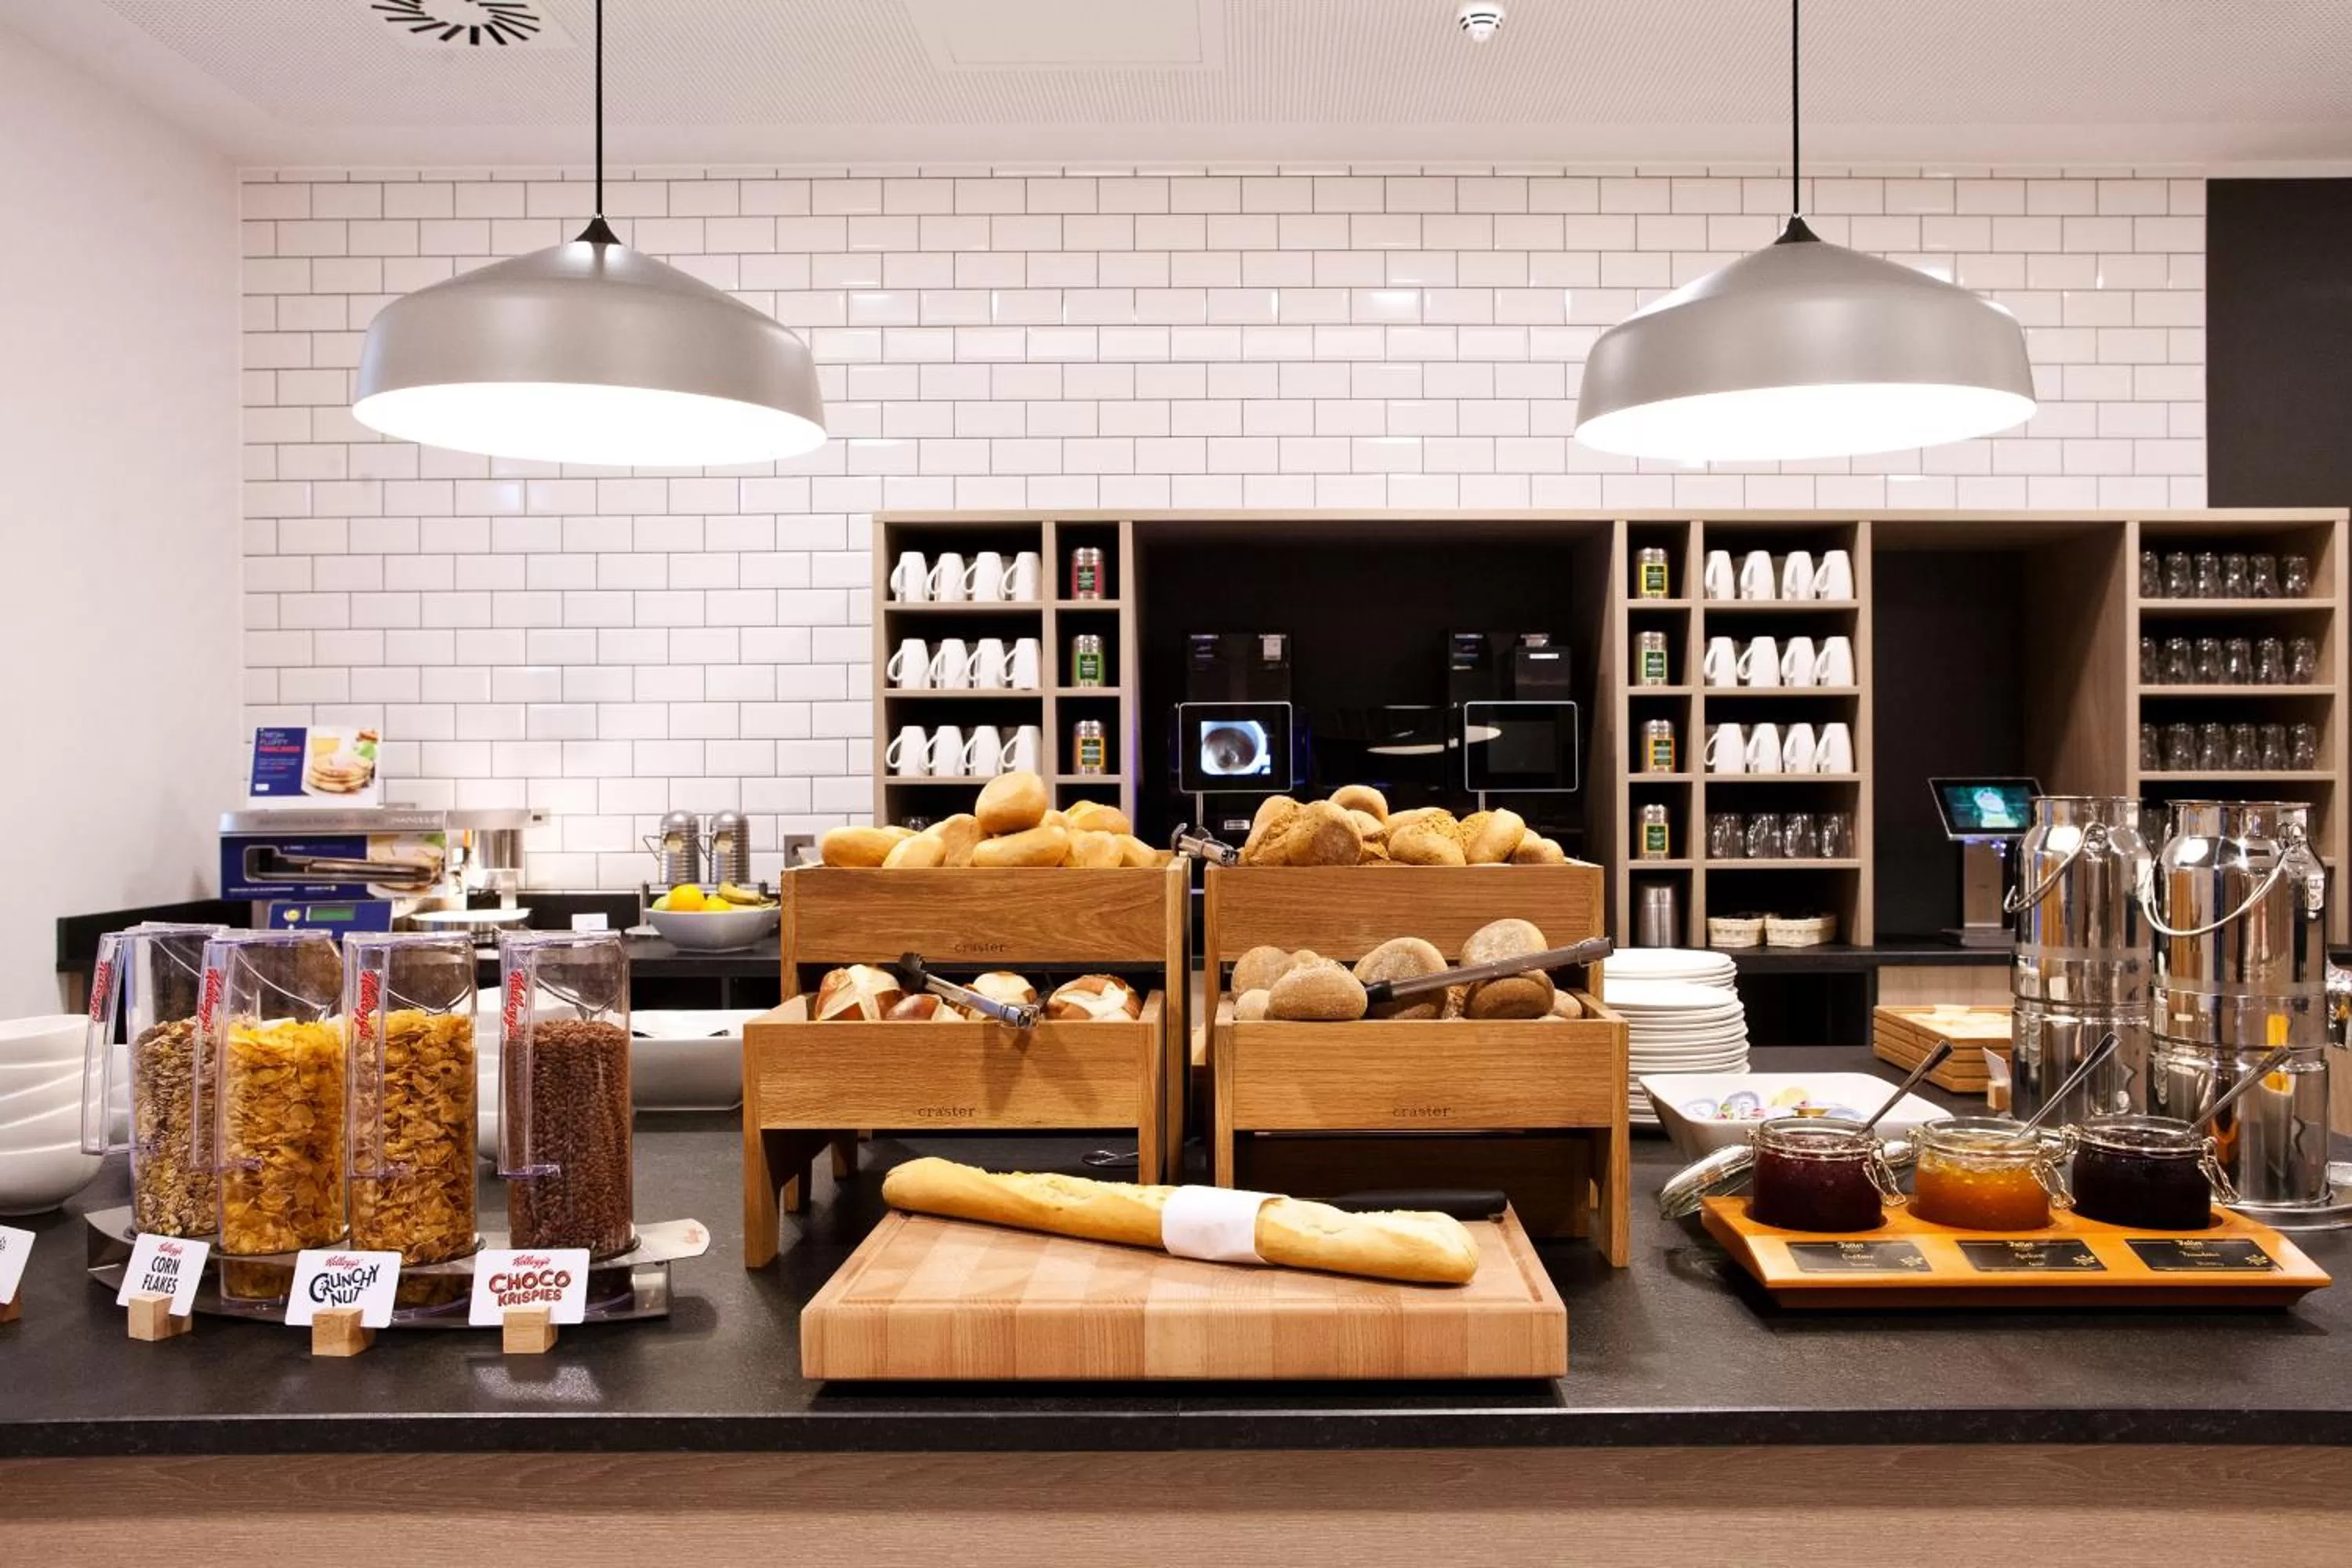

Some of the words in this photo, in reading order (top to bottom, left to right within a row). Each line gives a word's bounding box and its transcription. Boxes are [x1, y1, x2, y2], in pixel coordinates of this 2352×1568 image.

[918, 1106, 975, 1117] craster
[151, 1255, 181, 1276] CORN
[142, 1273, 179, 1294] FLAKES
[308, 1264, 380, 1303] CRUNCHY
[488, 1269, 572, 1294] CHOCO
[330, 1287, 363, 1307] NUT
[497, 1289, 562, 1306] KRISPIES
